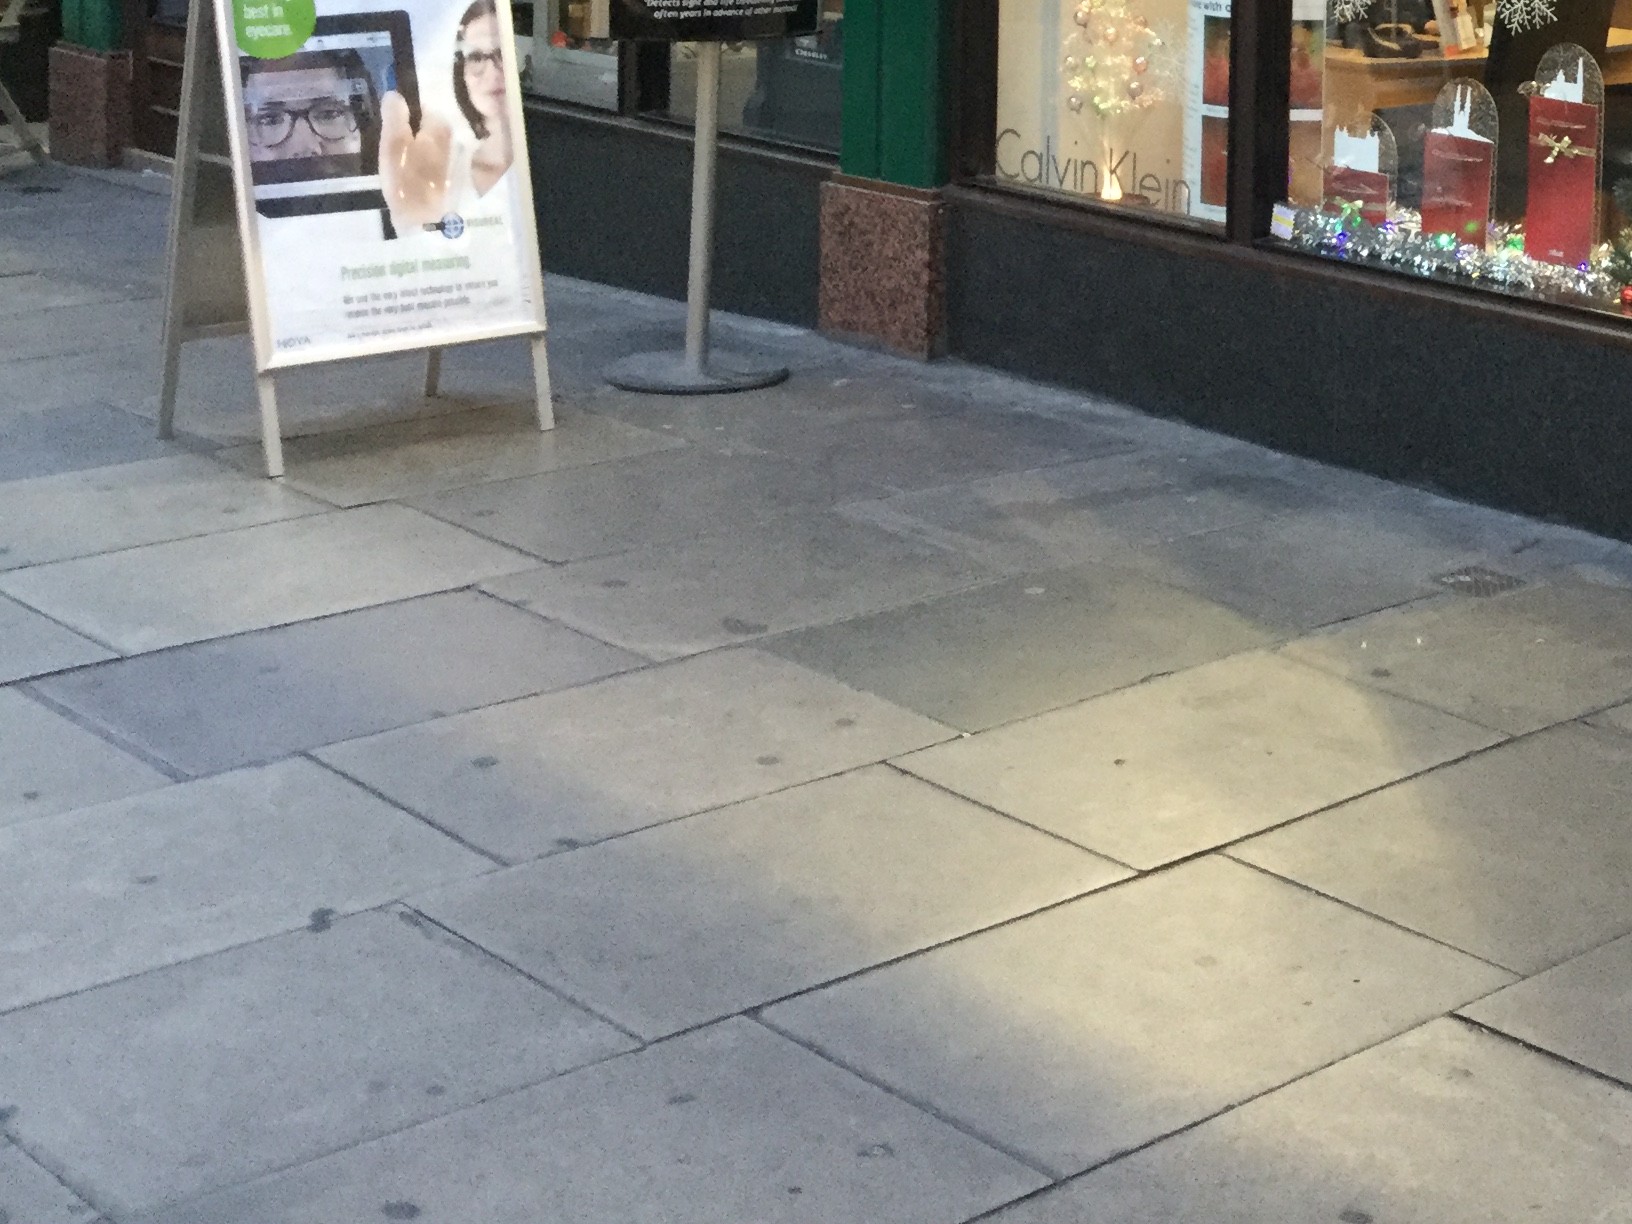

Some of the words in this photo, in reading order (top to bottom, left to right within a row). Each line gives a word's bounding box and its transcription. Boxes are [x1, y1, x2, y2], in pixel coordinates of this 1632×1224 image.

[243, 3, 269, 20] best
[272, 3, 284, 19] in
[995, 127, 1098, 194] Calvin
[1109, 147, 1191, 216] Klein
